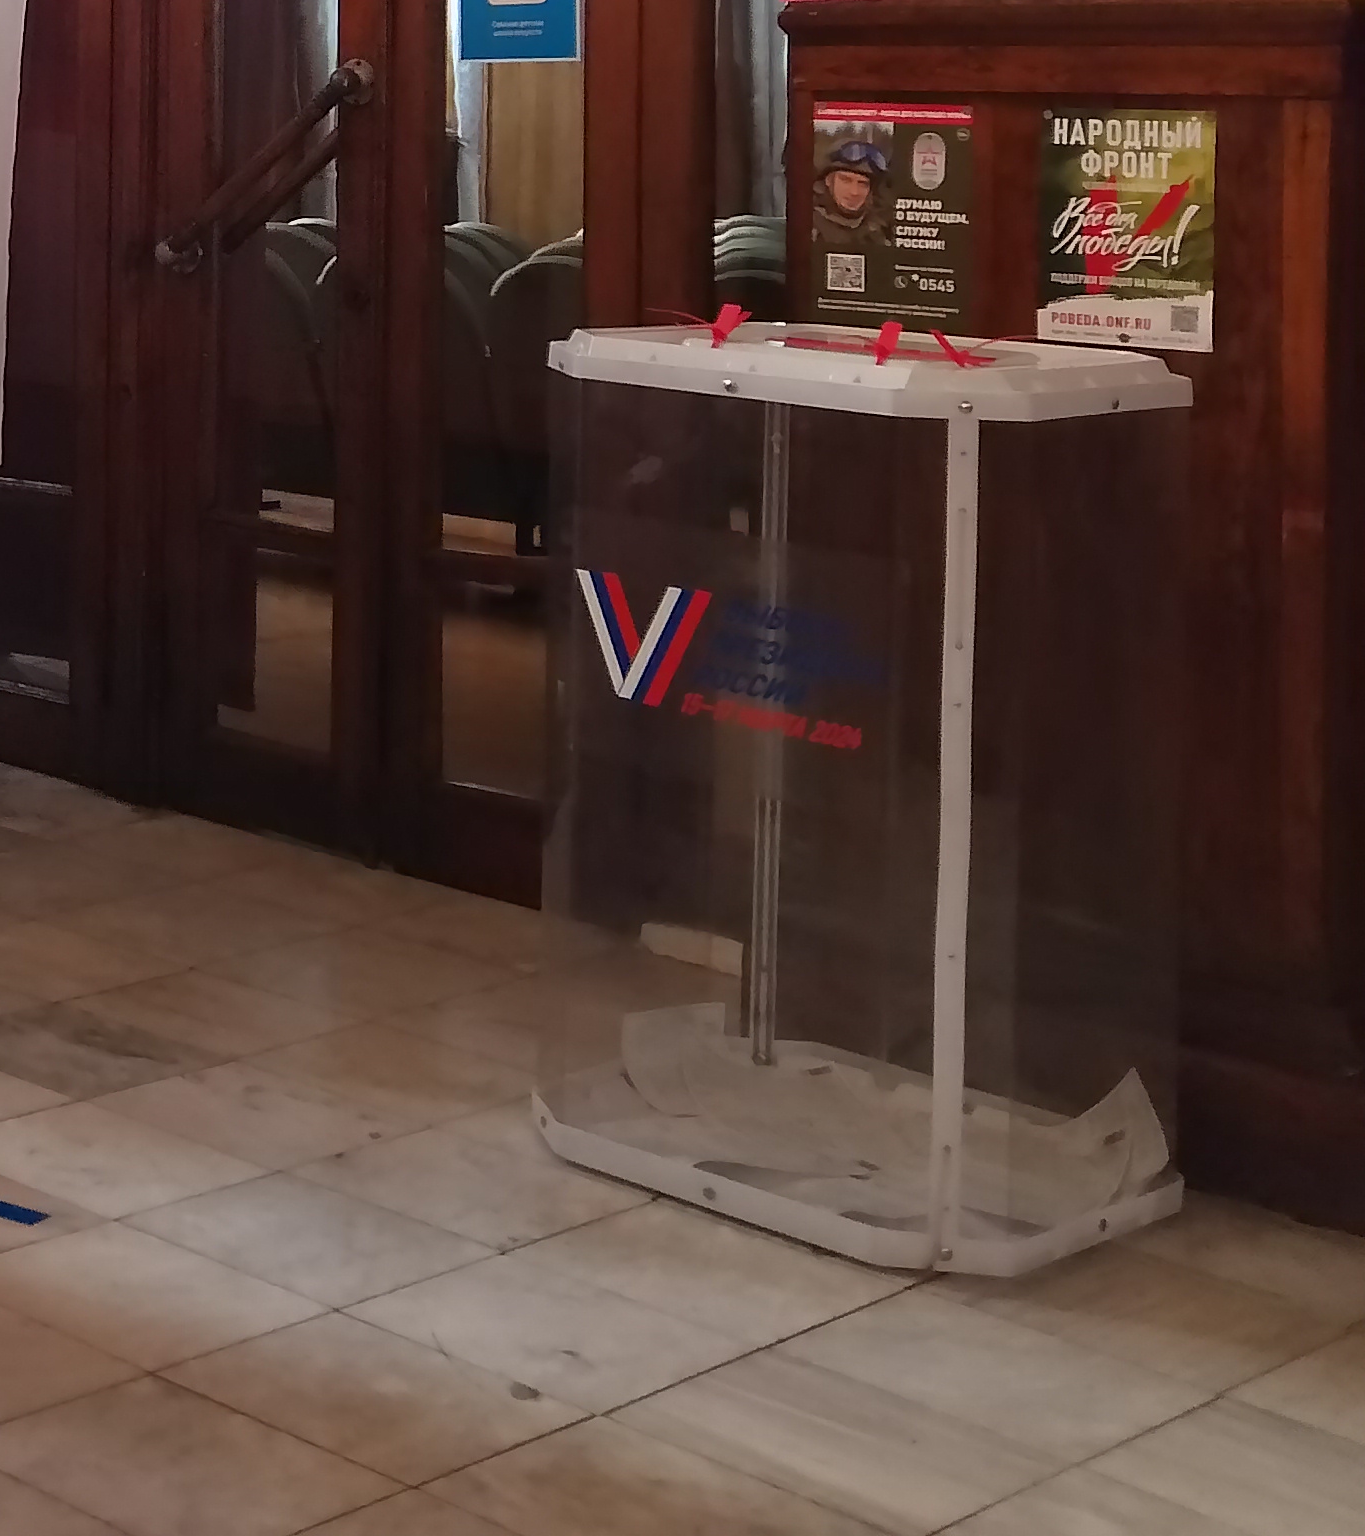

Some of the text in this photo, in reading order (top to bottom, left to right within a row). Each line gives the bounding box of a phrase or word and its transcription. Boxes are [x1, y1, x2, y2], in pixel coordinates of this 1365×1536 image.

[1053, 116, 1202, 150] НАРОДНЫЙ
[1080, 149, 1172, 179] ФРОНТ
[895, 198, 942, 210] ДУМАЮ
[895, 211, 905, 221] О
[895, 226, 939, 238] СЛУЖУ
[895, 238, 946, 250] РОССИИ!
[1050, 311, 1152, 331] POBEDA.ONF.RU
